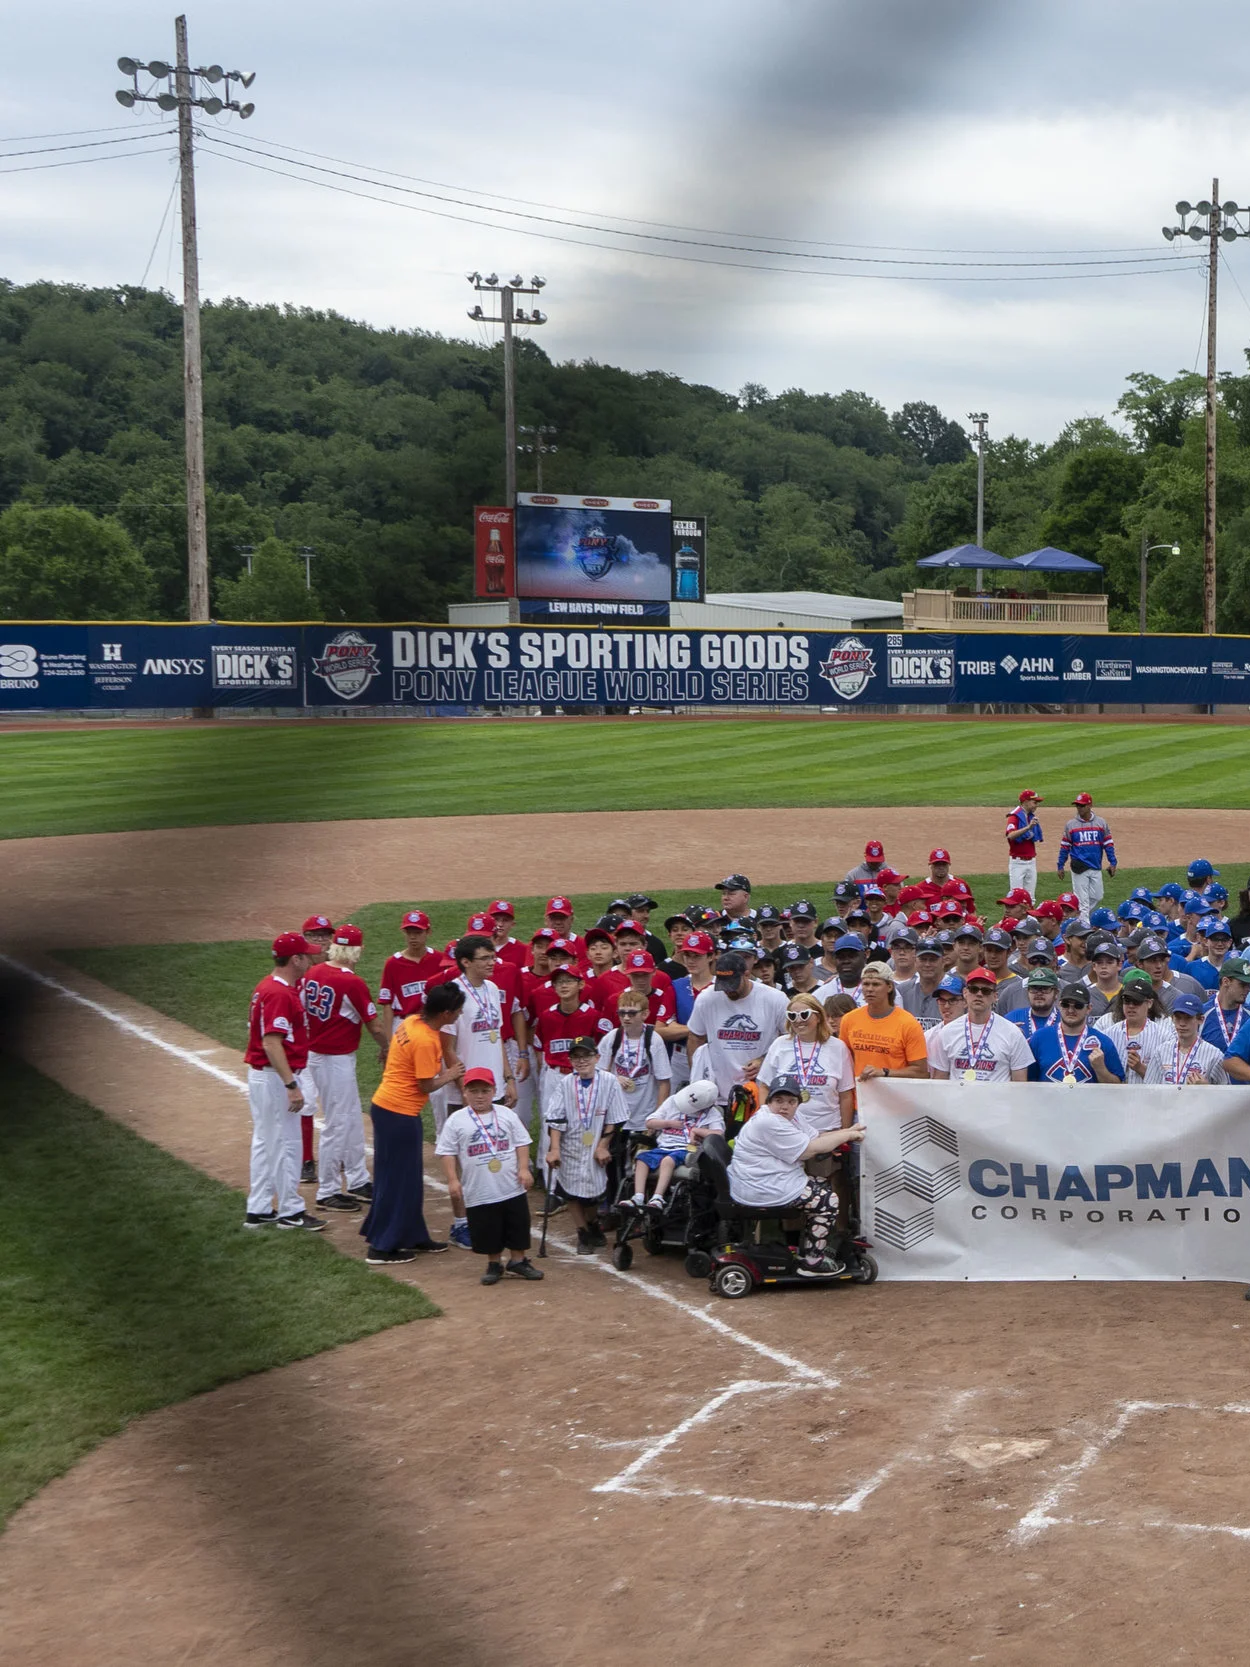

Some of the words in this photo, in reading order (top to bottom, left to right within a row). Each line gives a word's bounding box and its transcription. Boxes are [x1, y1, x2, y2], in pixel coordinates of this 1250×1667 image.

[673, 520, 697, 529] POWER
[673, 529, 702, 537] THROUGH
[549, 602, 568, 613] LEW
[569, 602, 593, 614] HAYS
[594, 603, 618, 614] PONY
[619, 604, 644, 615] FIELD
[888, 636, 902, 646] 285
[327, 646, 373, 657] PONY
[519, 632, 691, 670] SPORTING
[700, 633, 810, 670] GOODS
[831, 650, 869, 661] PONY
[143, 658, 205, 675] ANSYS
[324, 660, 348, 673] WORLD
[348, 658, 371, 669] SERIES
[829, 664, 849, 675] WORLD
[848, 661, 869, 671] SERIES
[958, 661, 990, 675] TRIB
[1020, 658, 1054, 672] AHN
[1063, 672, 1092, 681] LUMBER
[1, 679, 39, 689] BRUNO
[392, 669, 476, 701] PONY
[484, 670, 597, 701] LEAGUE
[604, 670, 704, 701] WORLD
[711, 671, 809, 701] SERIES
[305, 980, 336, 1023] 23
[575, 1036, 584, 1045] P
[717, 1029, 761, 1042] CHAMPIONS
